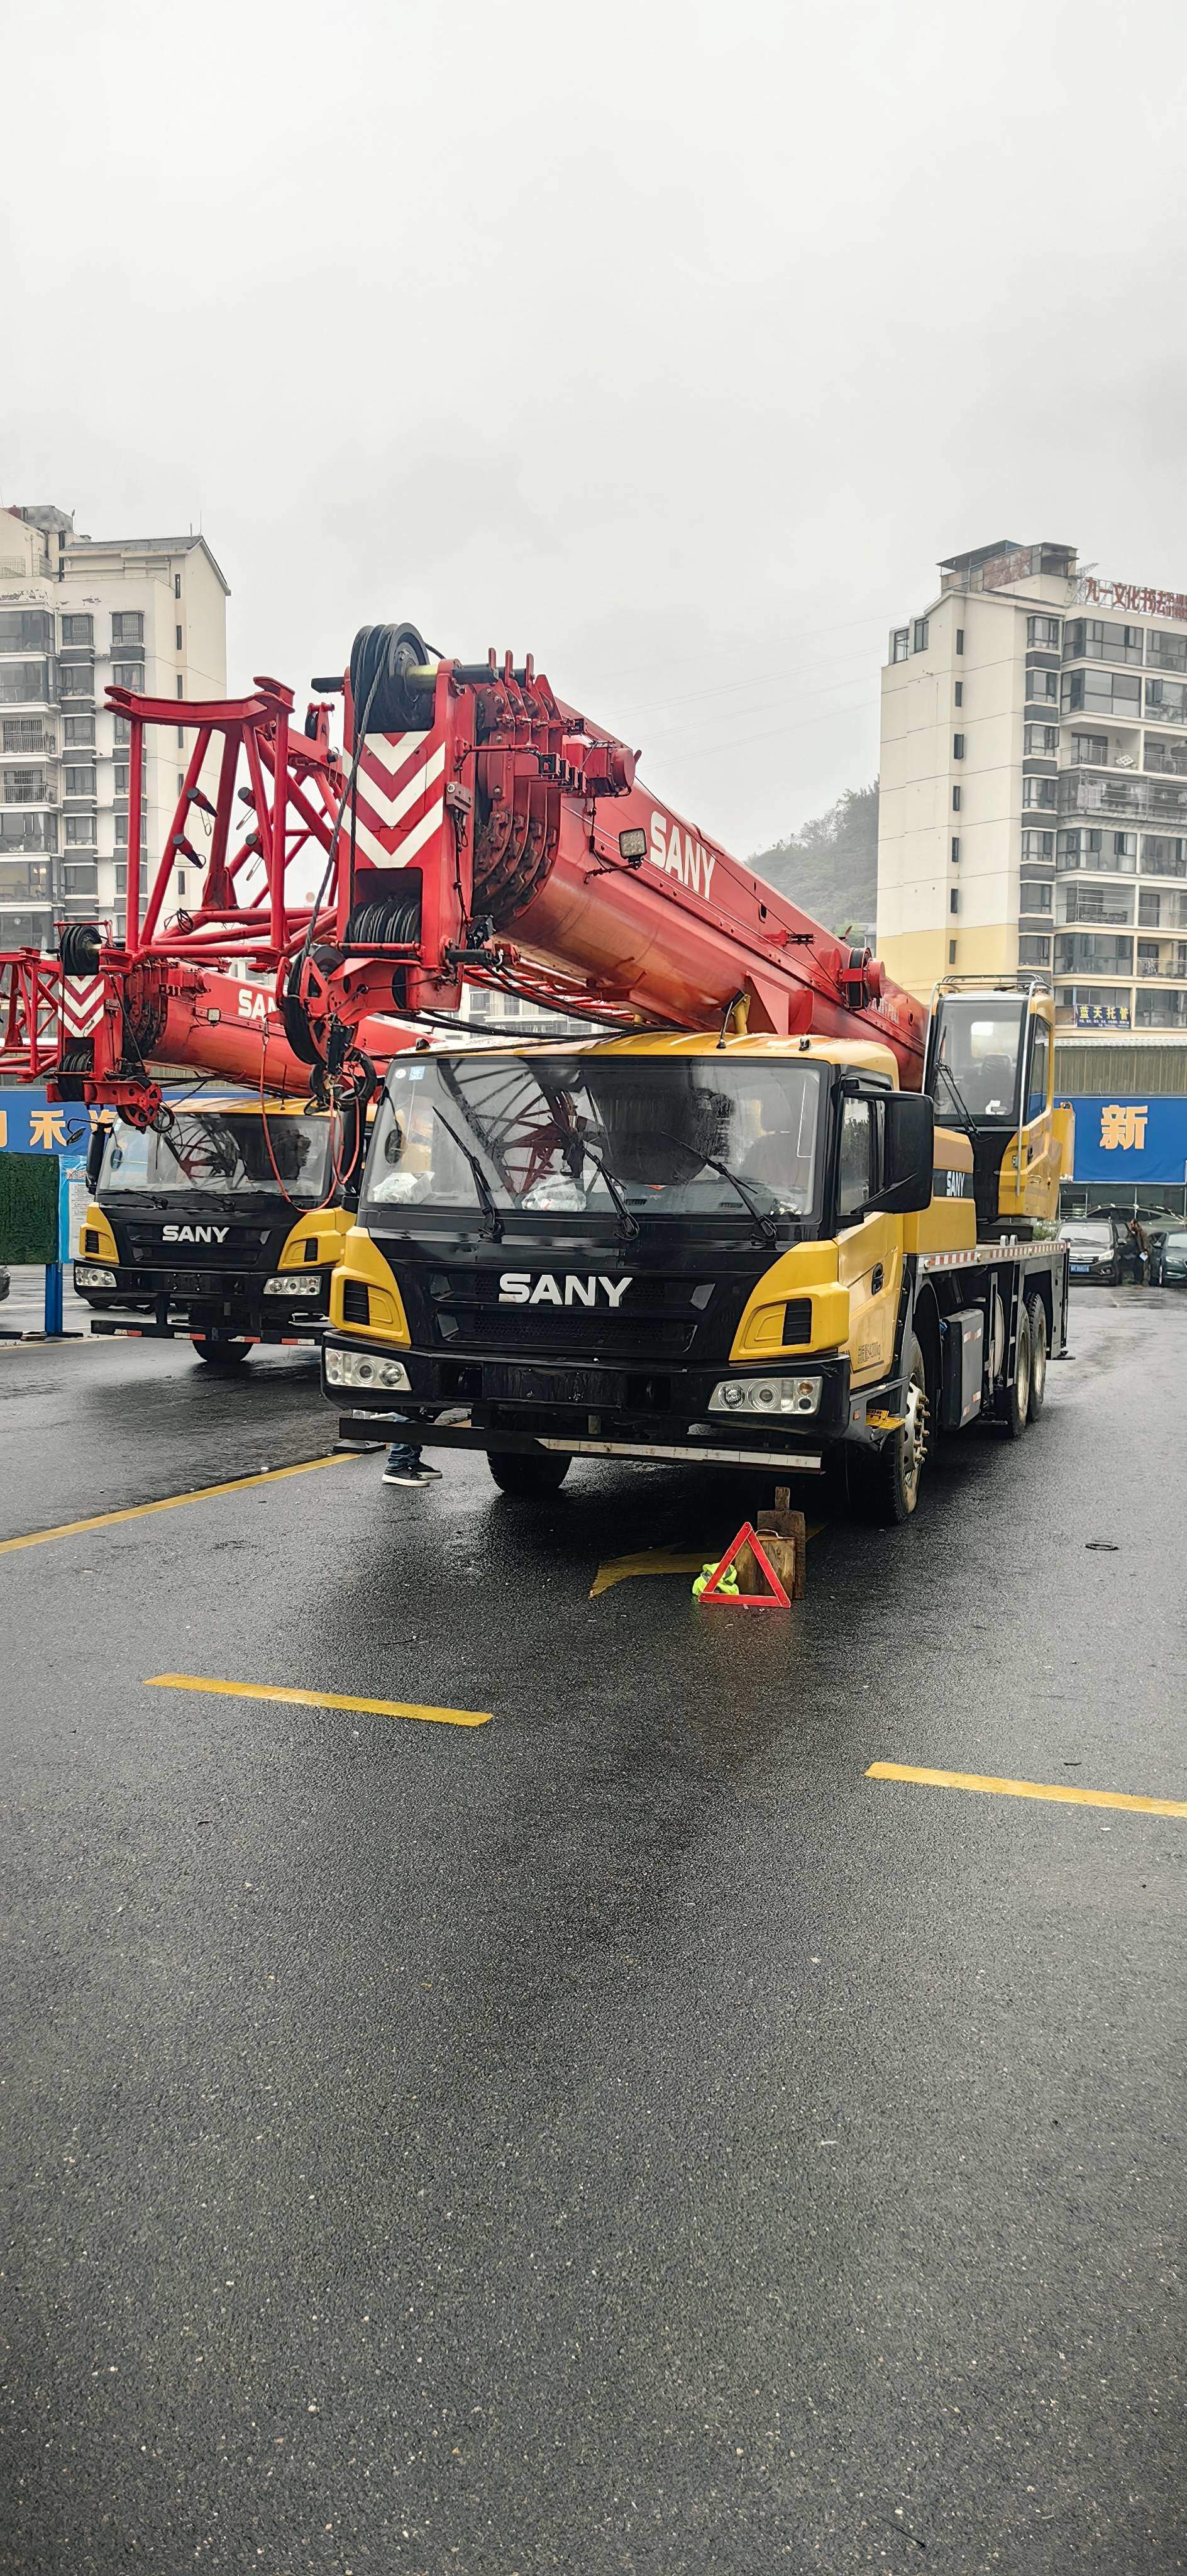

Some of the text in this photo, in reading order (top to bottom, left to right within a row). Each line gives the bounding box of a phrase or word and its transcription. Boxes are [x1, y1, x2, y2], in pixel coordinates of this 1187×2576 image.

[650, 811, 716, 900] SANY
[238, 989, 280, 1022] SAN
[1079, 1006, 1129, 1020] 蓝天托管
[1100, 1104, 1148, 1150] 新
[946, 1171, 965, 1197] SANY
[162, 1225, 230, 1243] SANY
[499, 1273, 633, 1307] SANY
